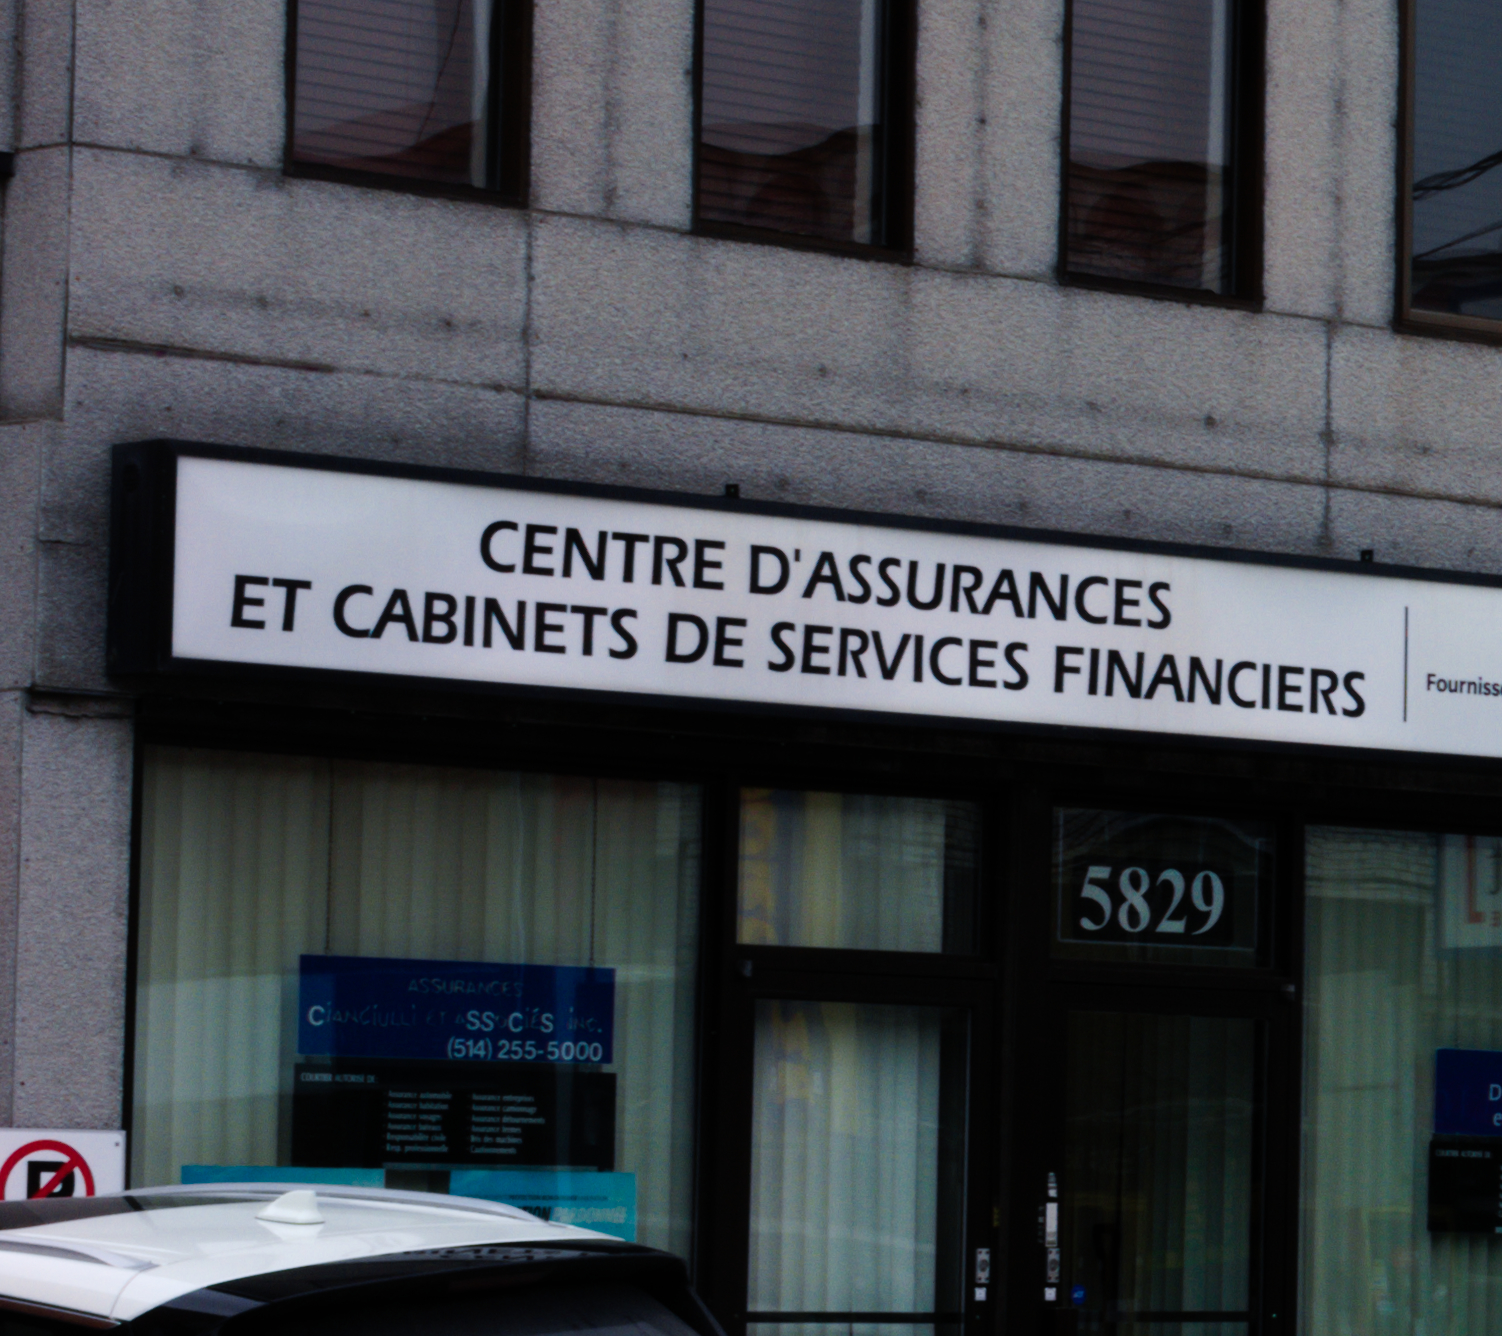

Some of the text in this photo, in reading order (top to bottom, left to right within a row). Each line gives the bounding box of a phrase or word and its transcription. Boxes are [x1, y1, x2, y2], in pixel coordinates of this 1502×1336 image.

[479, 520, 1173, 630] CENTRE D'ASSURANCES
[229, 574, 1367, 718] ET CABINETS DE SERVICES FINANCIERS
[1078, 865, 1226, 936] 5829
[406, 978, 524, 998] ASSURANCES
[446, 1035, 604, 1062] (514) 255-5000
